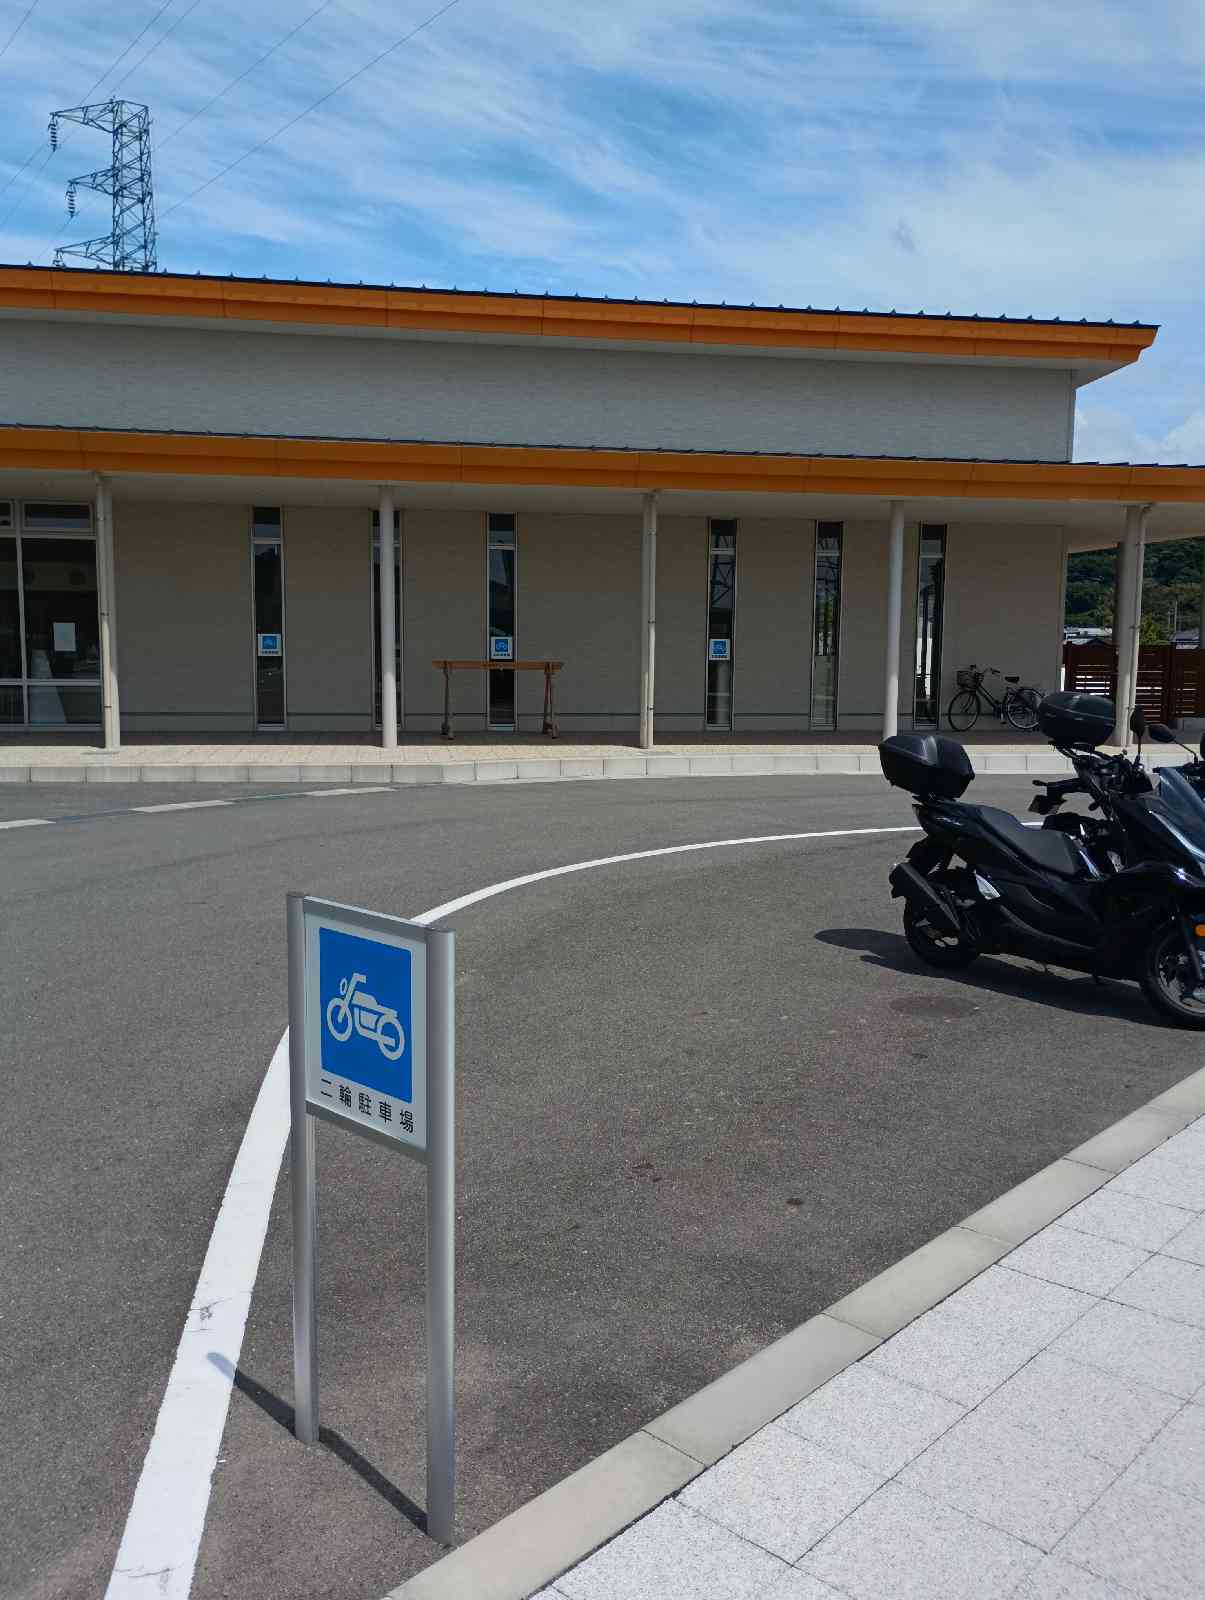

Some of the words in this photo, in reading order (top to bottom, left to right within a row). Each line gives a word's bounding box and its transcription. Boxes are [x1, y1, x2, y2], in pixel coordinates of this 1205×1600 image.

[320, 1078, 414, 1134] 二輪駐車場
